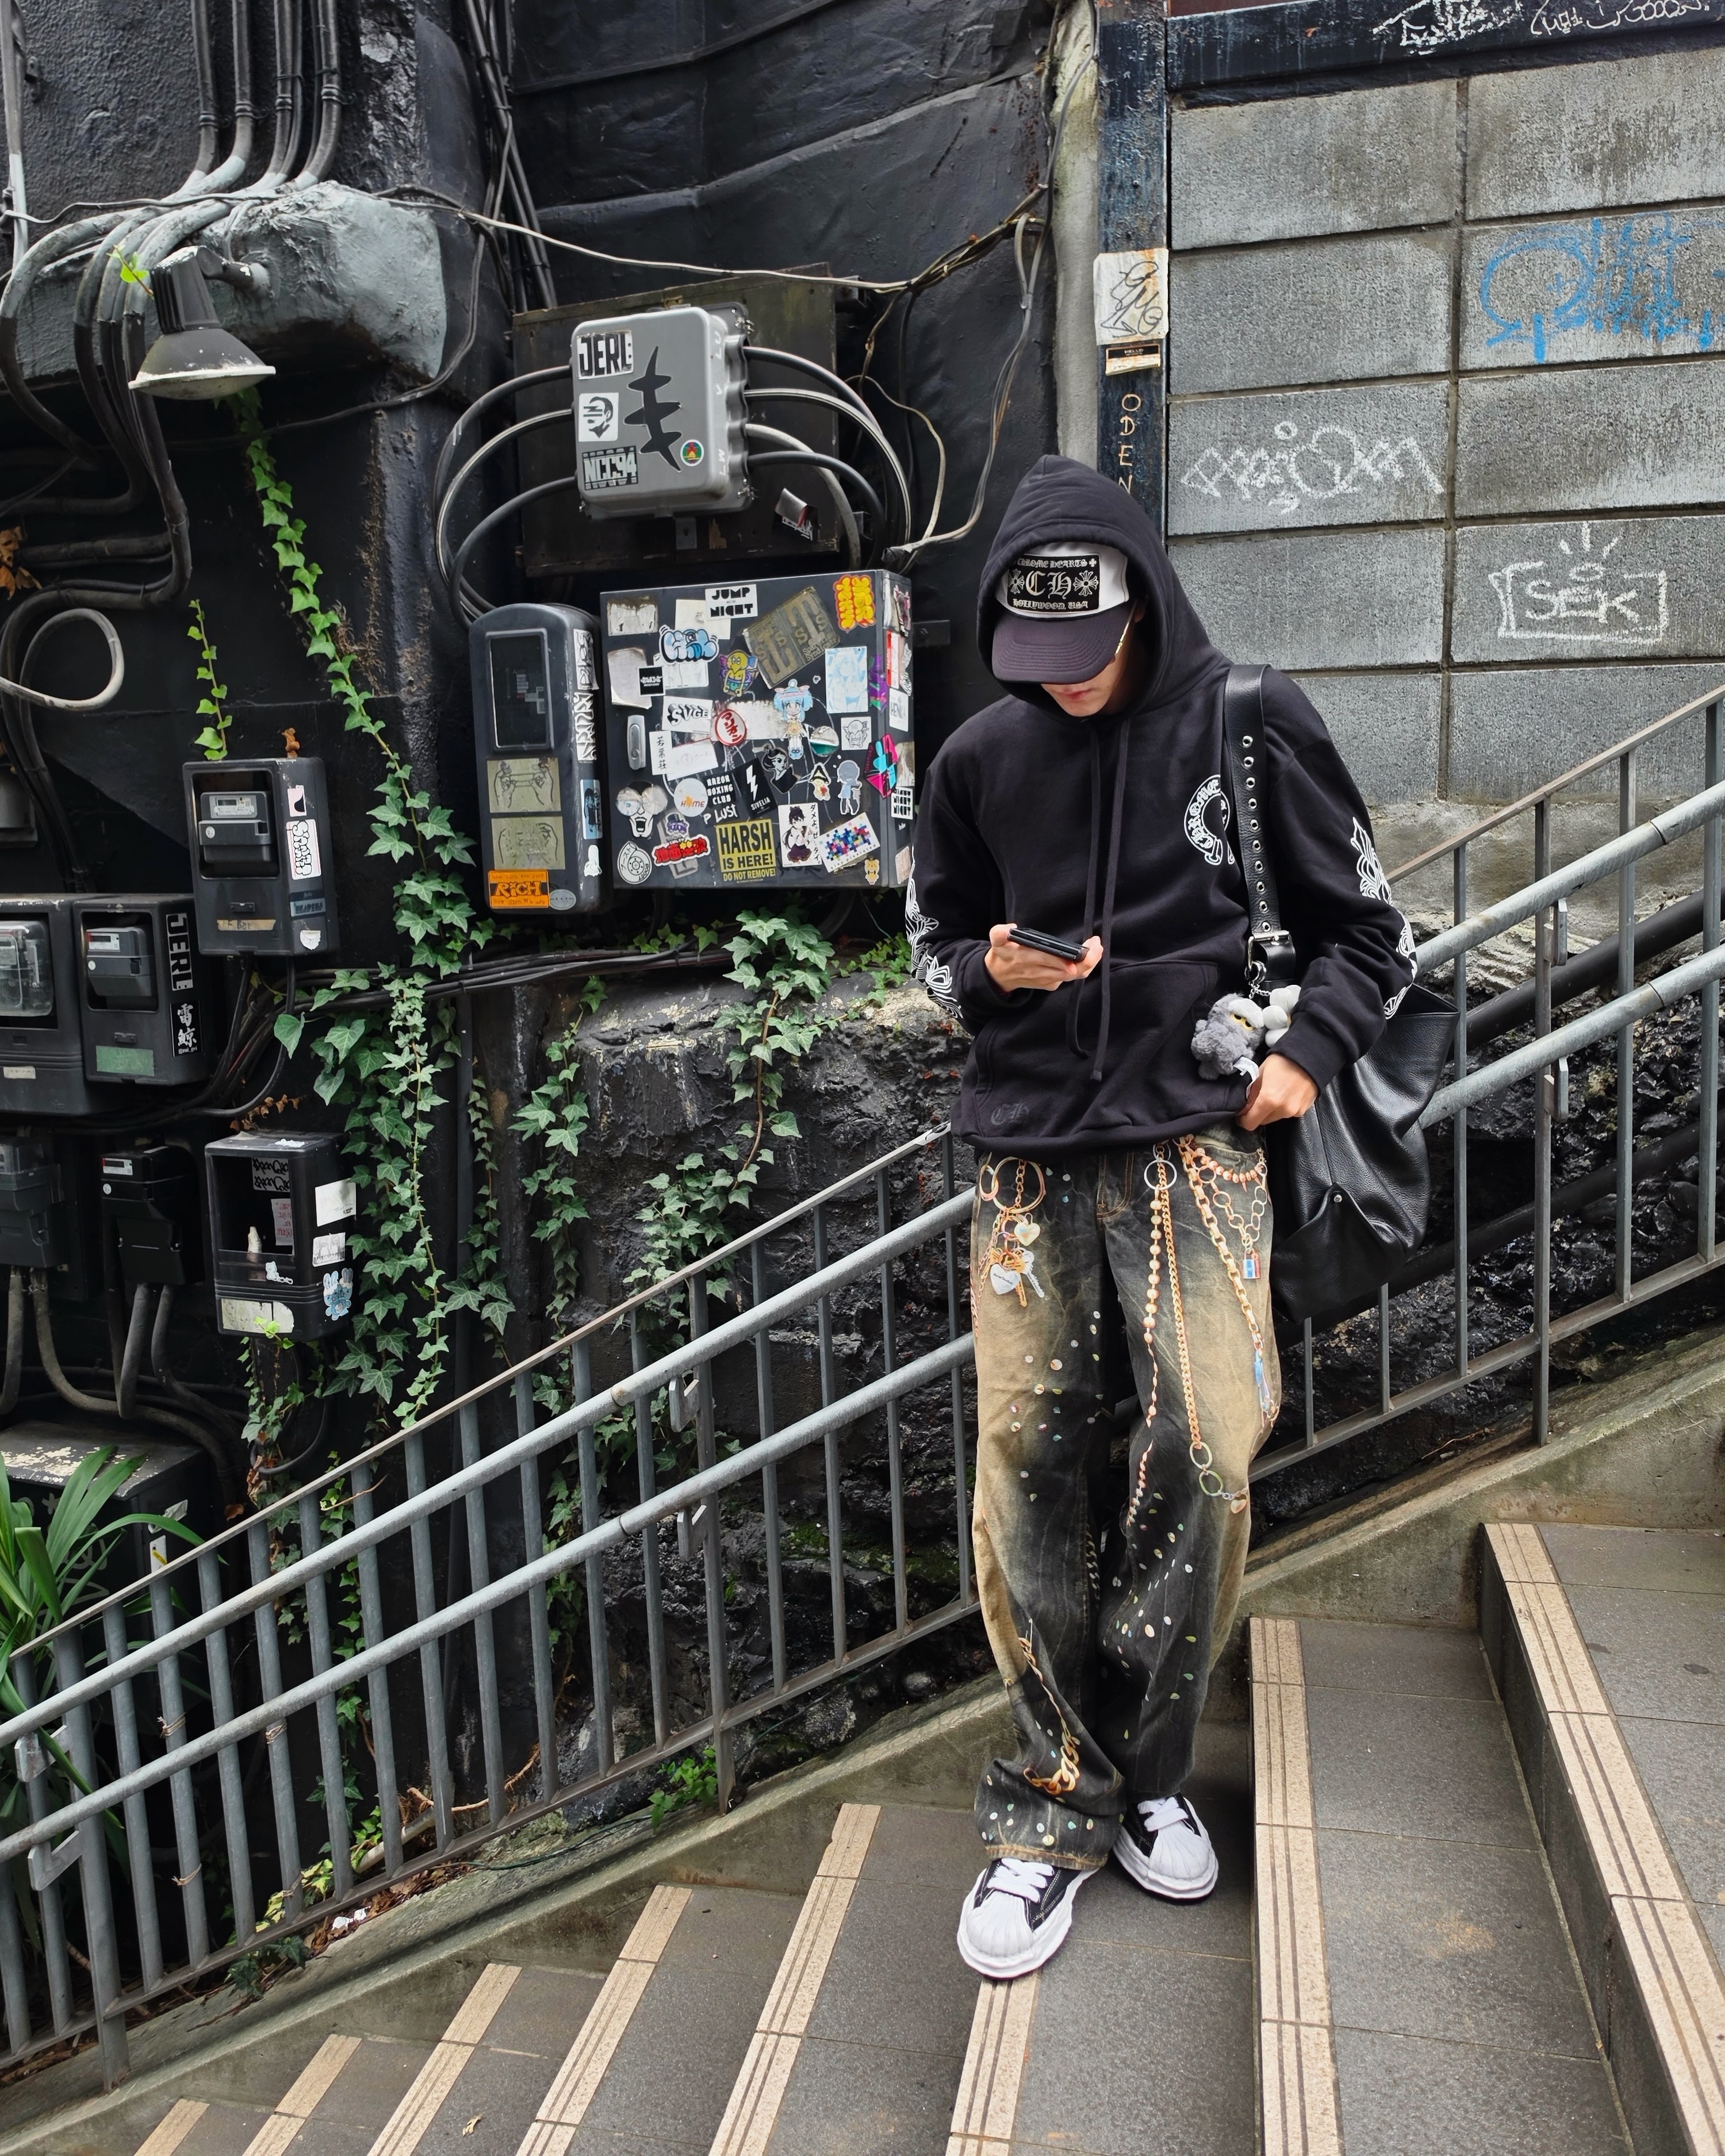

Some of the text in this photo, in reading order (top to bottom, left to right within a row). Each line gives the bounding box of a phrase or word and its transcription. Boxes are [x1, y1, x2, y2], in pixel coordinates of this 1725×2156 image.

[1025, 570, 1072, 600] CH
[711, 587, 750, 600] JUMP
[1068, 600, 1088, 609] USA
[707, 775, 730, 787] RAZOR
[707, 784, 733, 796] BOXING
[712, 795, 731, 805] CLUB
[718, 822, 772, 856] HARSH
[722, 853, 773, 870] IS HERE!
[723, 871, 733, 881] DO
[734, 870, 747, 880] NOT
